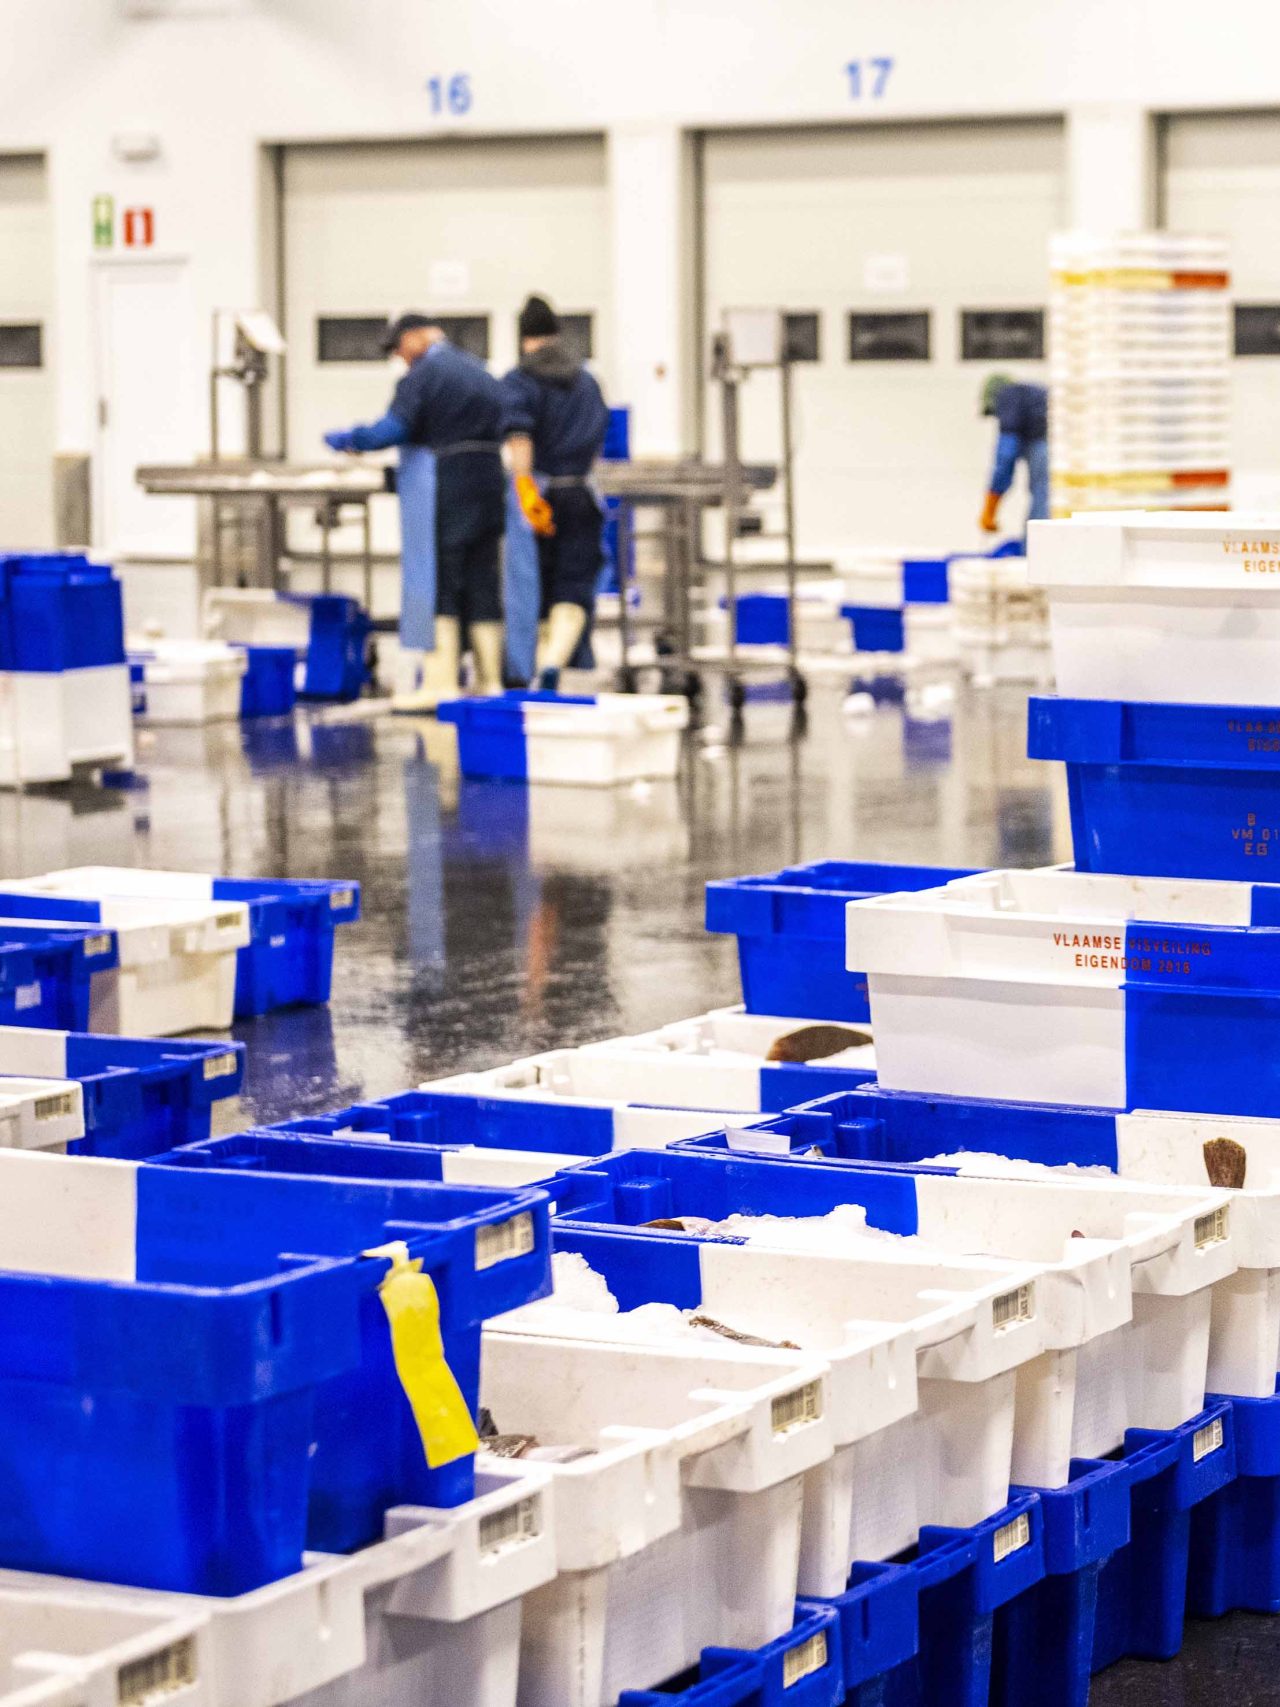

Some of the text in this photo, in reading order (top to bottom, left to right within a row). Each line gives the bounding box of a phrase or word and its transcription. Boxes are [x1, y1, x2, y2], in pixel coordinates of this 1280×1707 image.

[847, 57, 895, 100] 17
[427, 74, 473, 117] 16
[1232, 828, 1253, 841] VM
[1245, 843, 1268, 856] EG
[1053, 933, 1122, 950] VLAAMSE
[1075, 953, 1190, 975] EIGENDOM 2016
